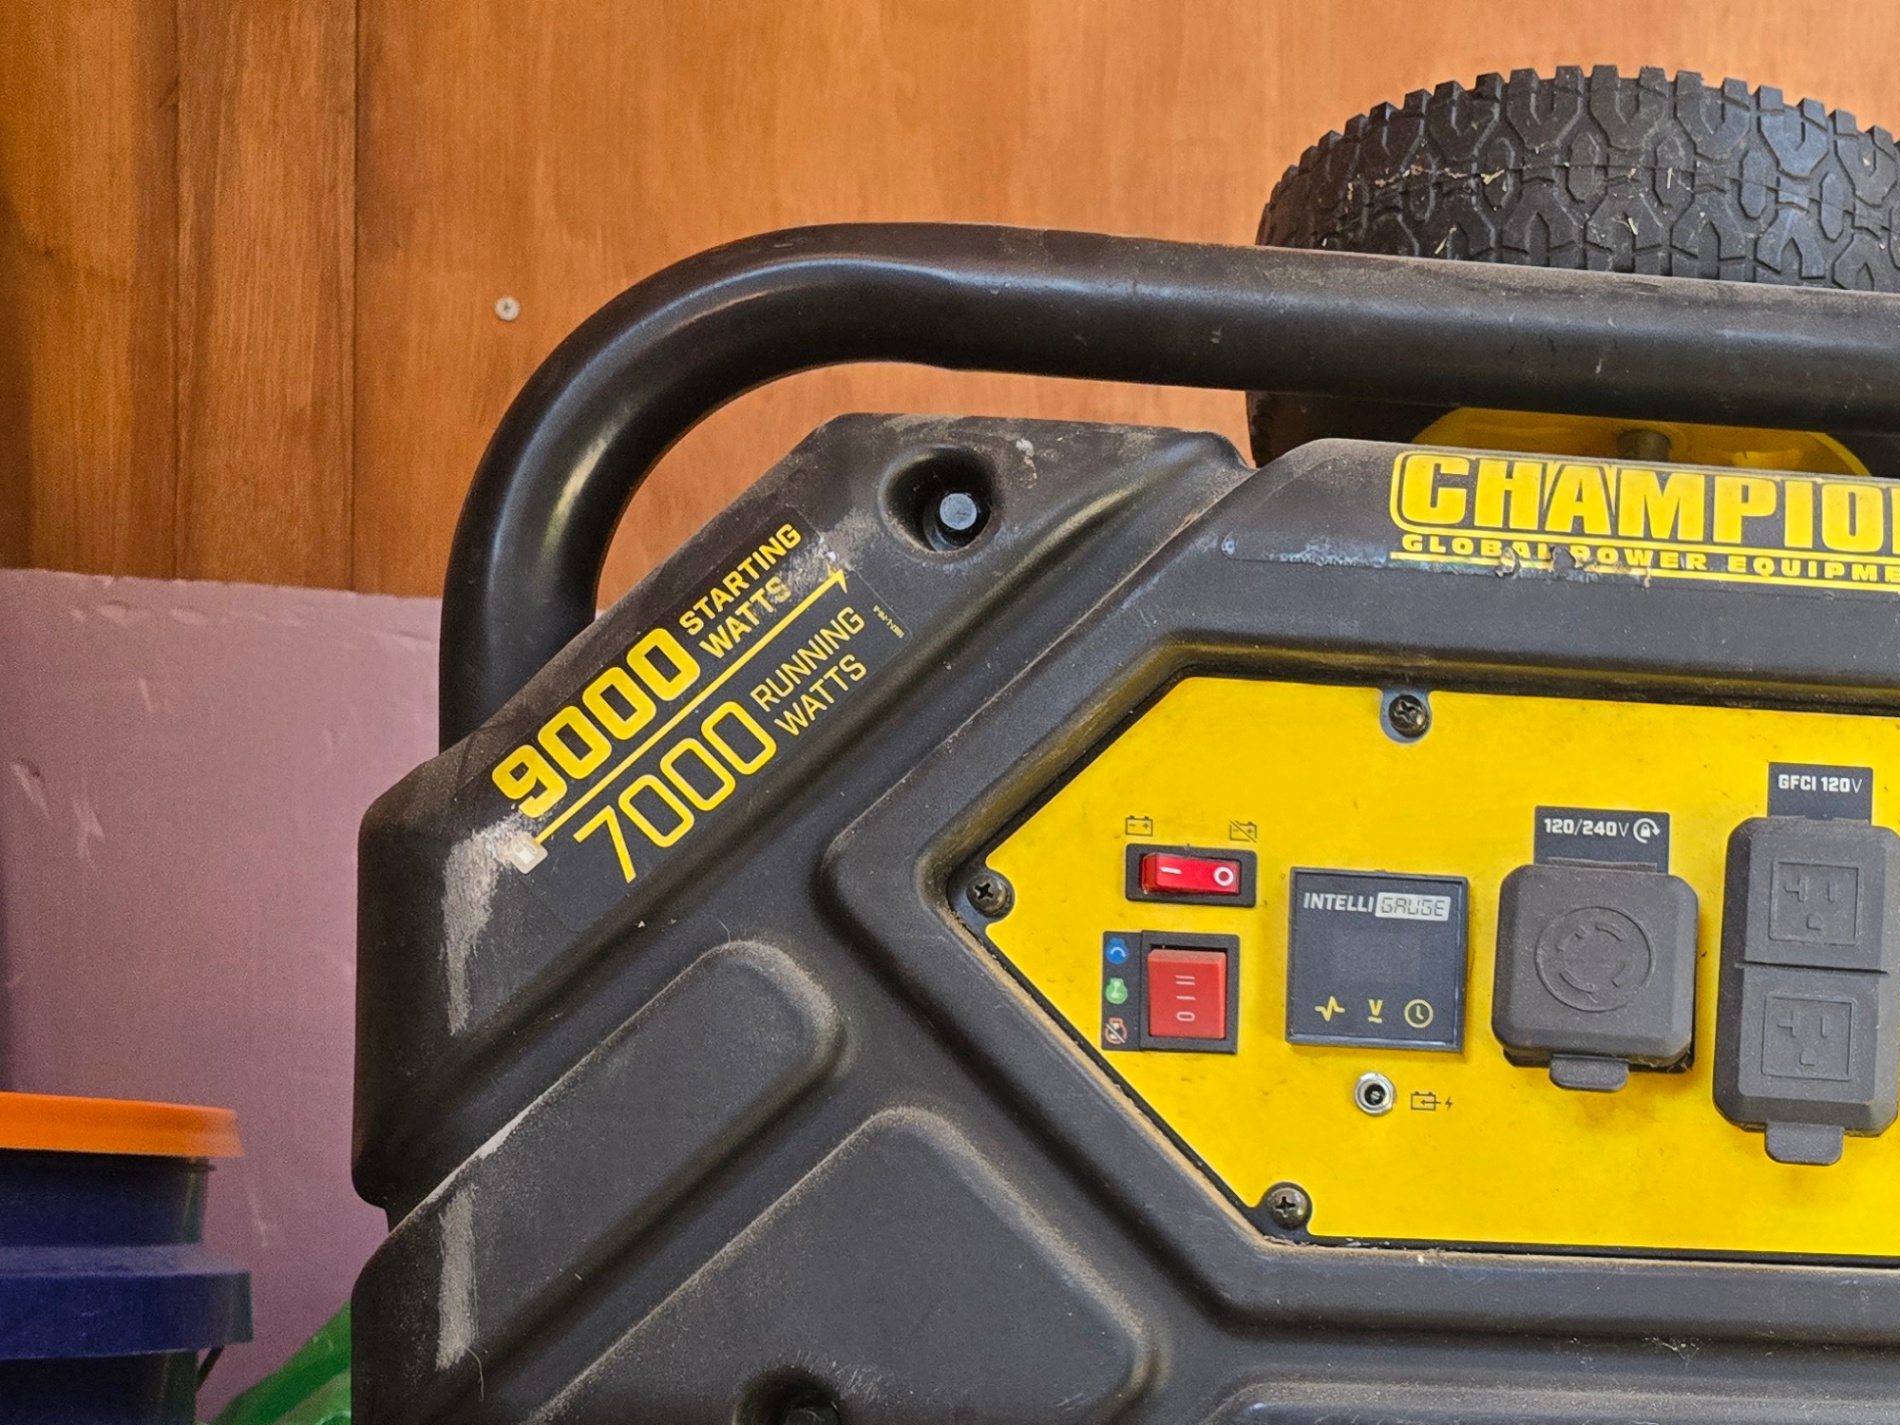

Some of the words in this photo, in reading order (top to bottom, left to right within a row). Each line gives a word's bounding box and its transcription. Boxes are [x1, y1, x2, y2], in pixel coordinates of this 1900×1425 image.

[699, 576, 792, 659] WATTS
[491, 627, 700, 819] 9000
[679, 523, 801, 637] STARTING
[774, 654, 867, 737] WATTS
[573, 700, 777, 883] 7000
[750, 606, 866, 712] RUNNING
[1778, 774, 1817, 792] GFCI
[1821, 776, 1863, 794] 120V
[1544, 818, 1631, 838] 120/240V
[1303, 892, 1373, 913] INTELLI
[1379, 895, 1448, 919] GAUGE
